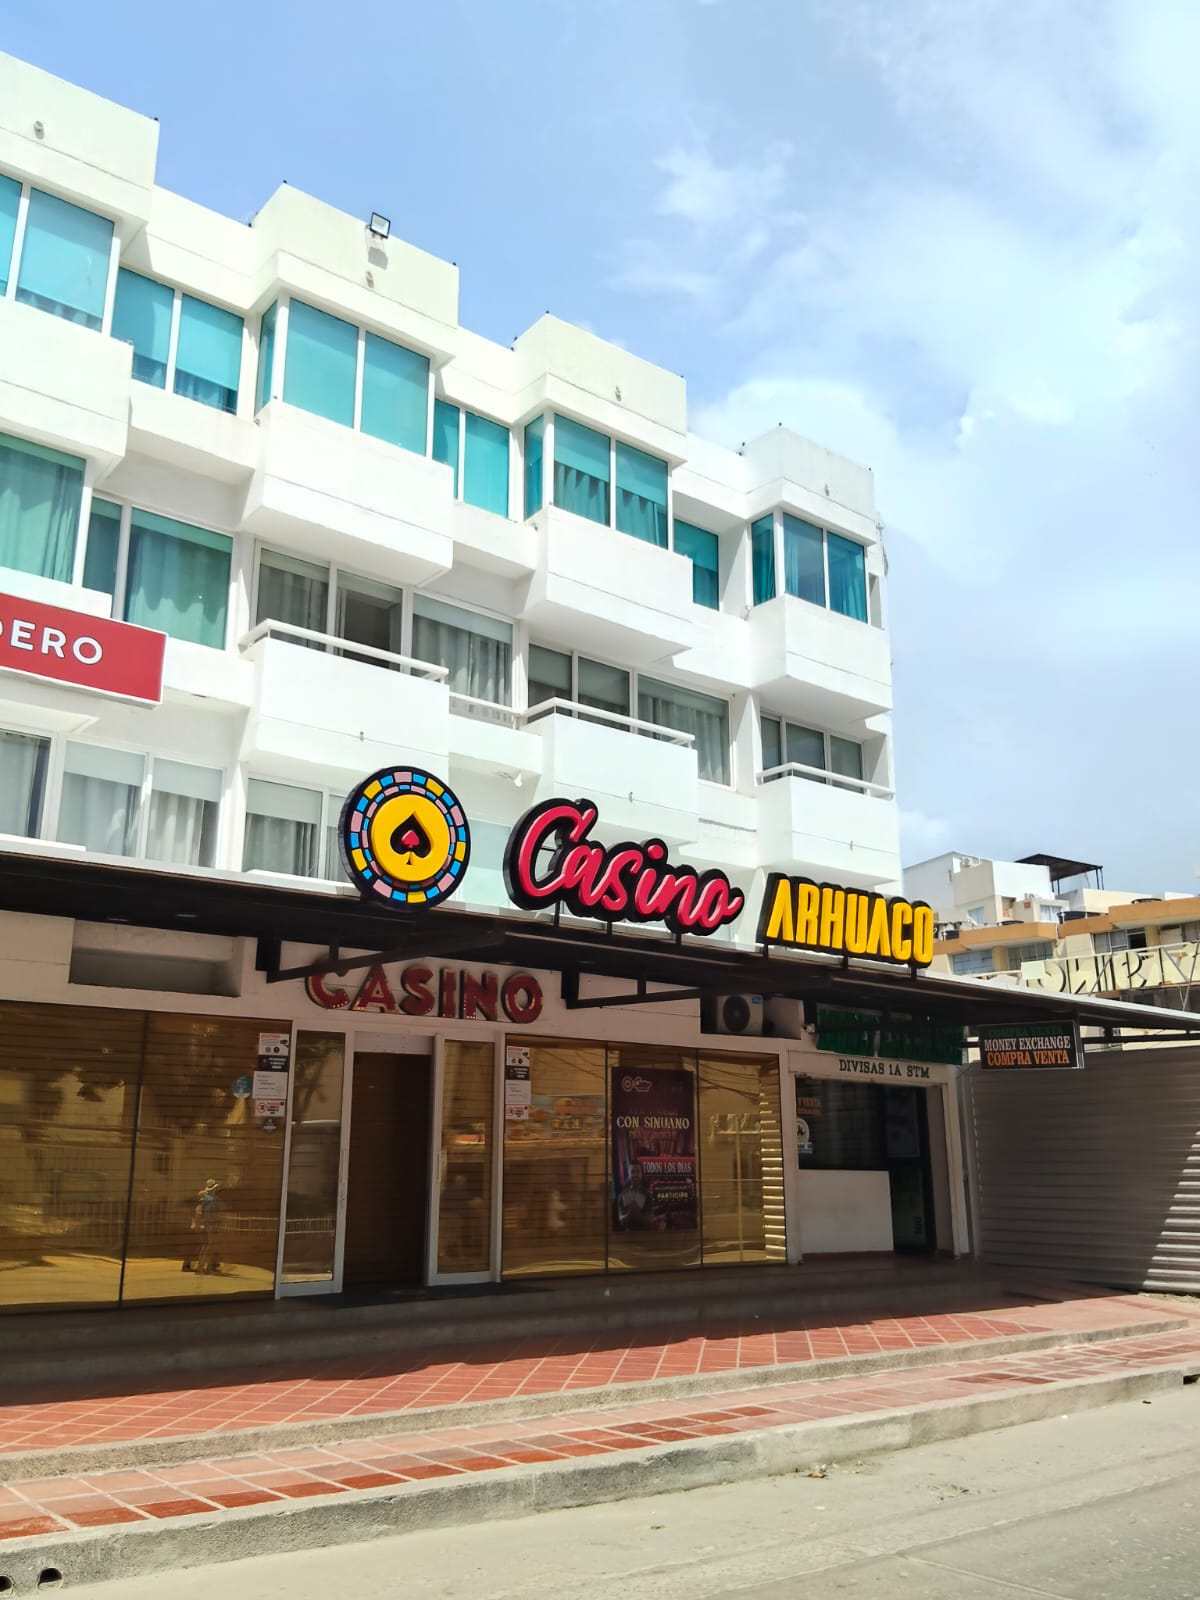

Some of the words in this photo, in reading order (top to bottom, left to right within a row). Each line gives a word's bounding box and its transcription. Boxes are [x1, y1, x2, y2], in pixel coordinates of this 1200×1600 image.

[0, 619, 103, 665] ERO
[518, 804, 744, 929] Casino
[766, 879, 934, 964] ARHUACO
[305, 957, 544, 1023] CASINO
[983, 1038, 1017, 1052] MONEY
[1018, 1035, 1071, 1050] EXCHANGE
[986, 1051, 1032, 1066] COMPRA
[1032, 1049, 1071, 1065] VENTA
[839, 1059, 885, 1075] DIVISAS
[906, 1065, 930, 1079] STM
[616, 1115, 640, 1129] CON
[643, 1161, 663, 1173] TODOS
[664, 1161, 676, 1173] LOS
